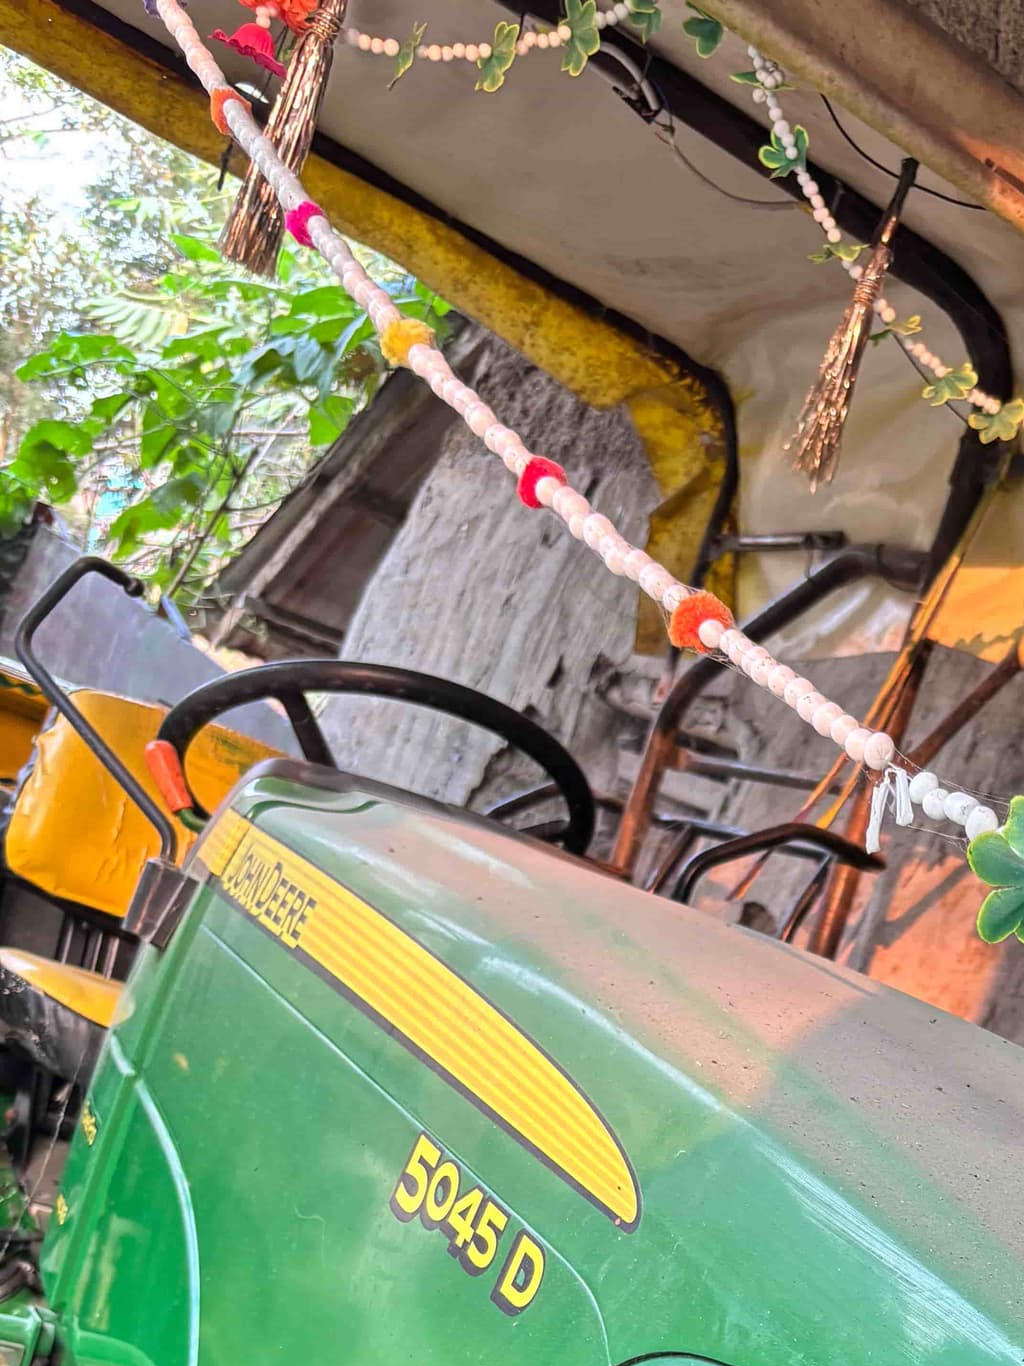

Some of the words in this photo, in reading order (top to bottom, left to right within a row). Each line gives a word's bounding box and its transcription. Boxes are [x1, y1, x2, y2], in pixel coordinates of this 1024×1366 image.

[256, 862, 318, 941] DEERE
[393, 1132, 510, 1272] 5045
[495, 1231, 545, 1312] D
